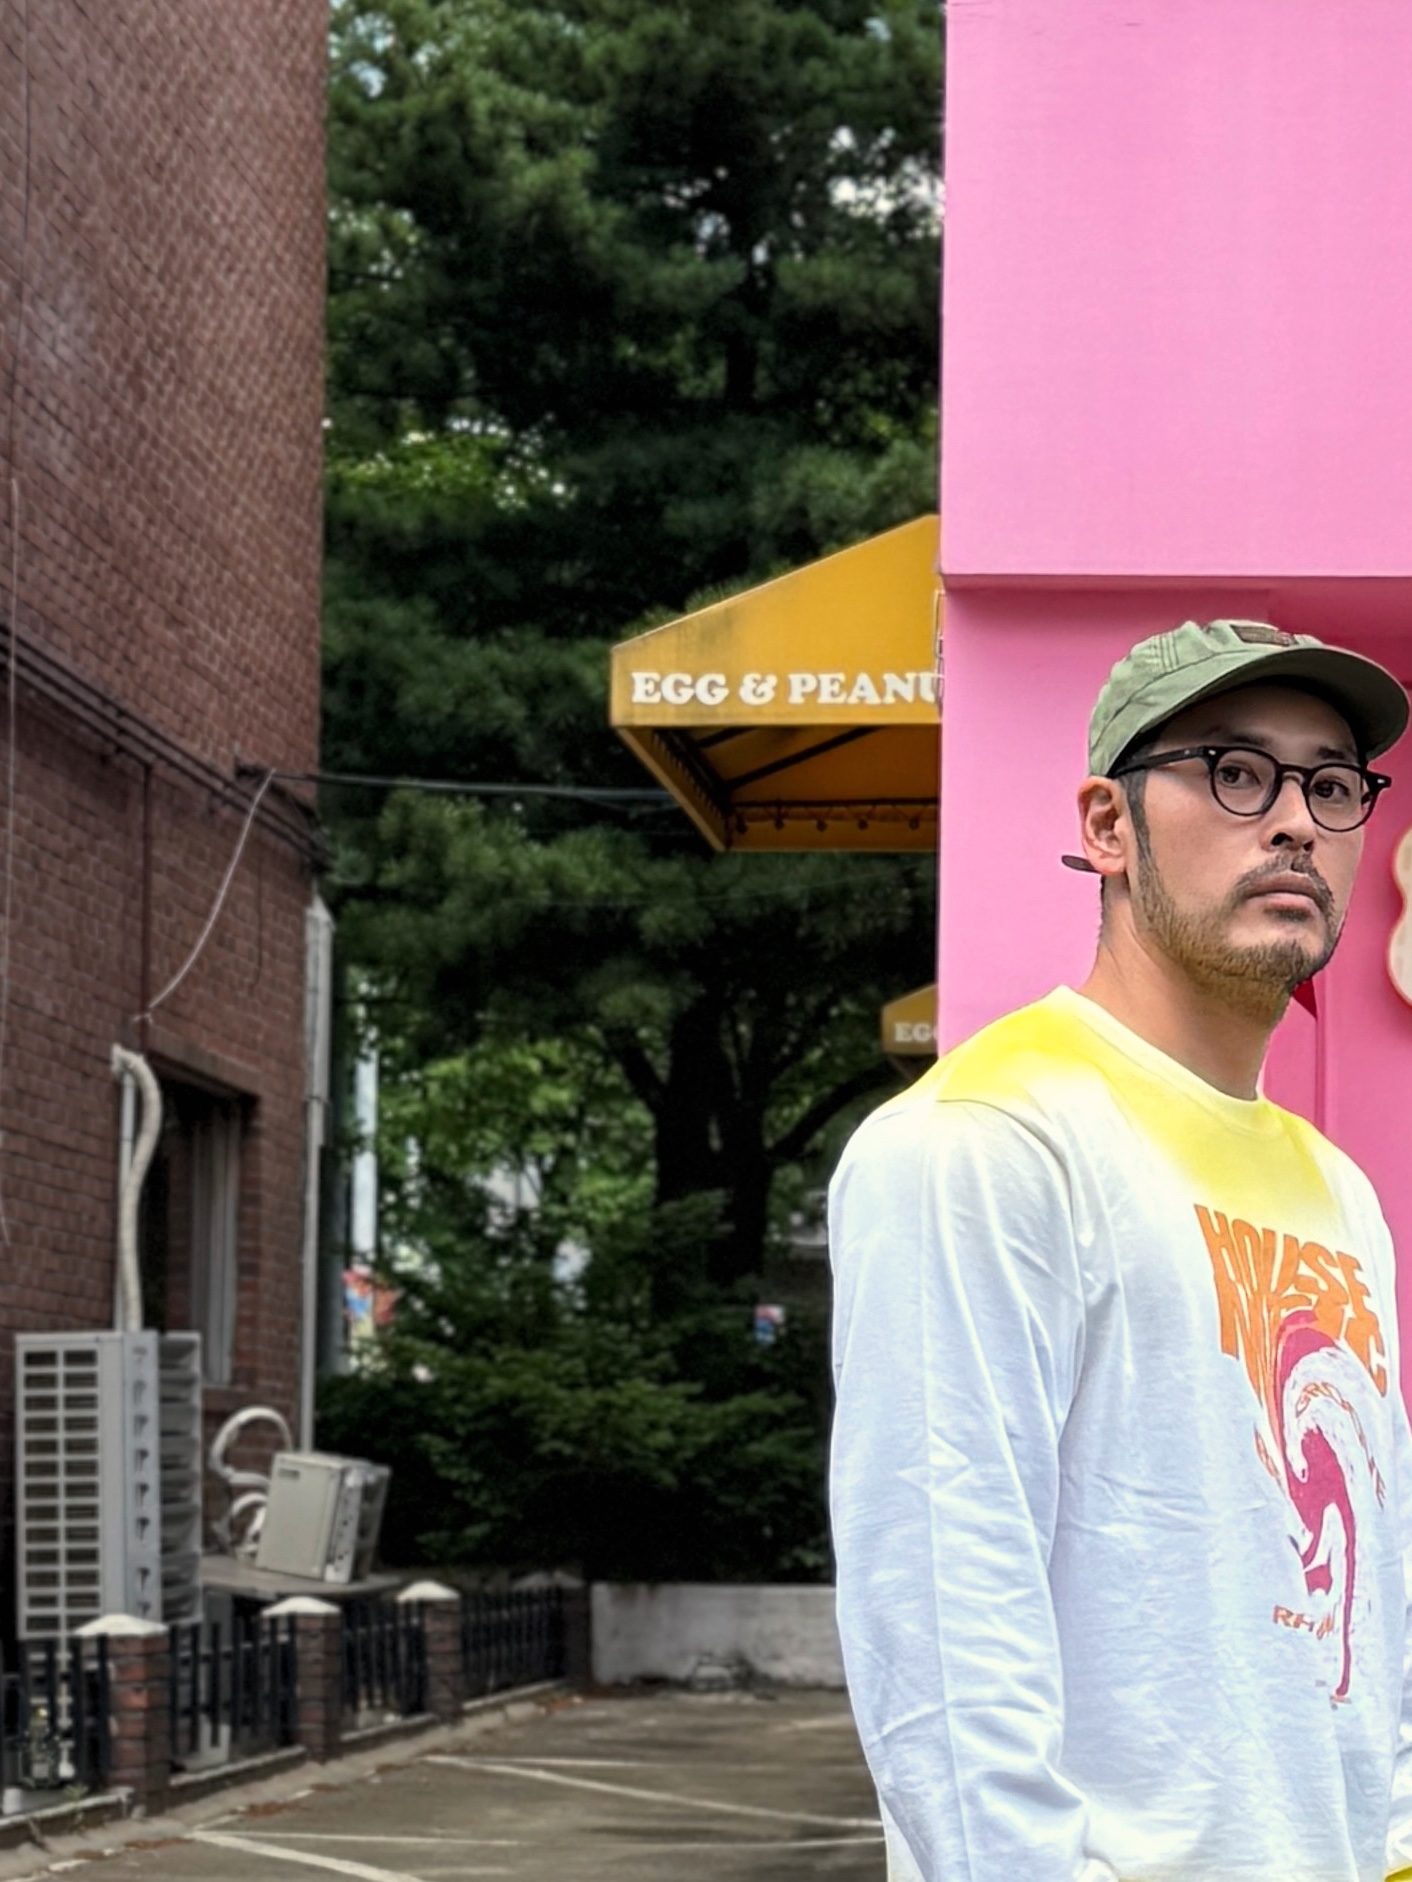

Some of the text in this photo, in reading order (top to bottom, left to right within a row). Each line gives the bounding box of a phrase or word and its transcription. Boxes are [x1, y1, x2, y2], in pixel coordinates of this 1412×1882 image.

[631, 671, 729, 706] EGG
[739, 672, 778, 705] &
[894, 1022, 939, 1043] EG
[1193, 1203, 1371, 1320] HOUSE
